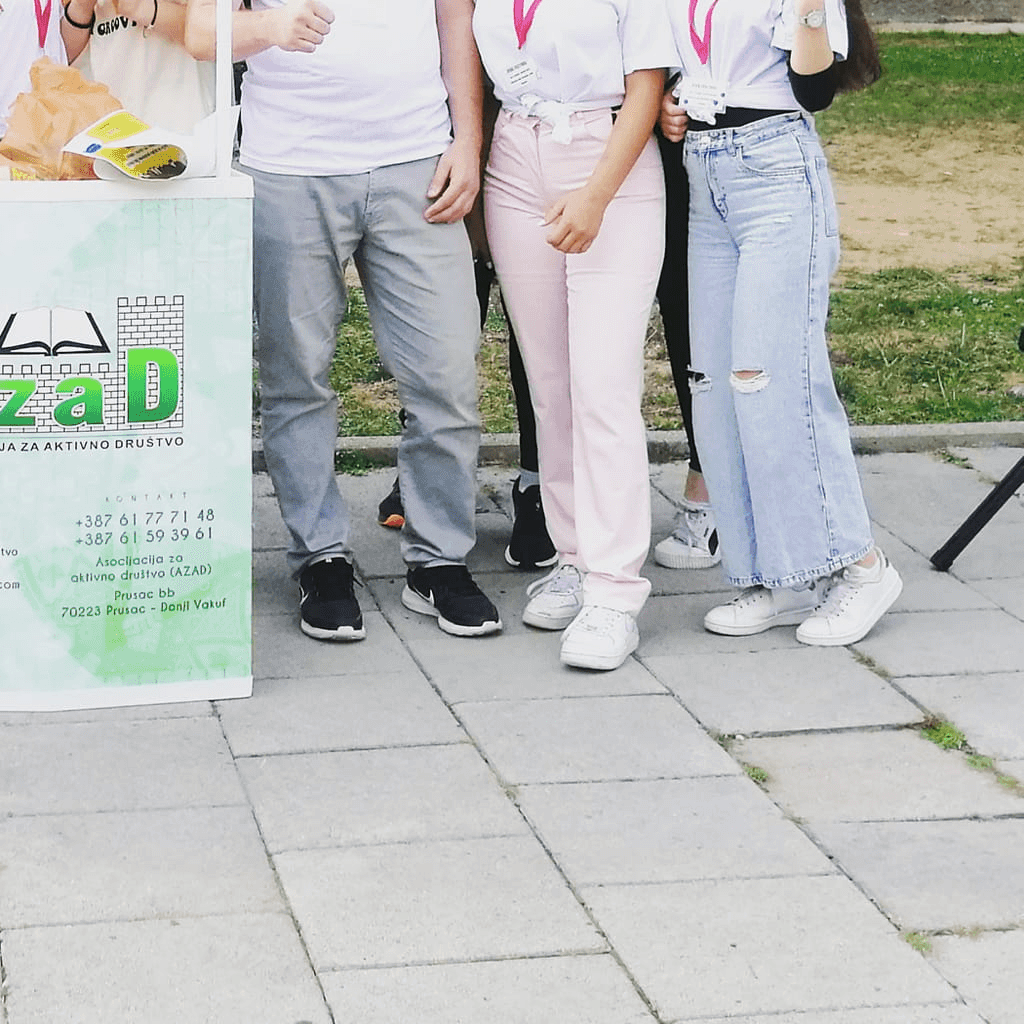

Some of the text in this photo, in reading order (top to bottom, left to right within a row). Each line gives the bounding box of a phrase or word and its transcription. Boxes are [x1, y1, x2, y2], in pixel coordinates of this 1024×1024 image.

[20, 442, 40, 452] ZA
[43, 440, 110, 452] AKTIVNO
[114, 436, 184, 449] DRUŠTVO
[76, 508, 215, 528] +387 61 77 71 48
[76, 526, 212, 546] +387 61 59 39 61
[95, 555, 183, 568] Asocijacija za
[70, 572, 116, 583] aktivno
[169, 563, 212, 578] (AZAD)
[114, 587, 176, 601] Prusac bb
[61, 605, 102, 618] 70223
[106, 604, 146, 616] Prusac
[193, 597, 226, 610] Vakuf
